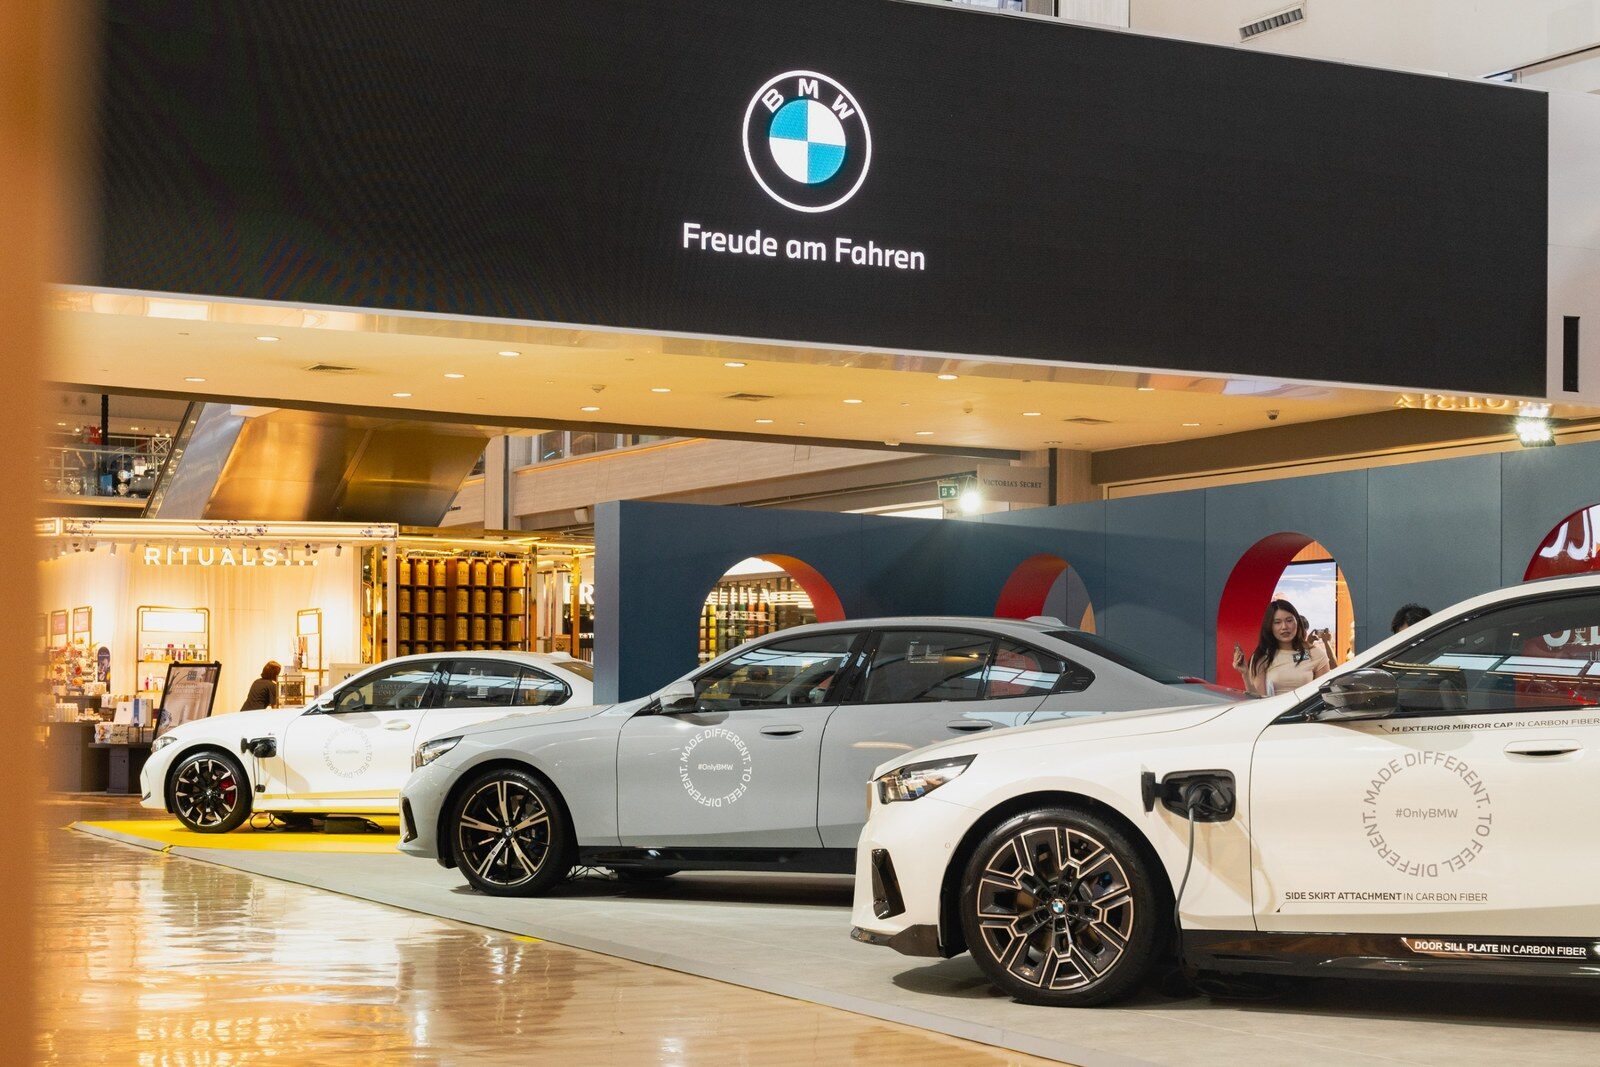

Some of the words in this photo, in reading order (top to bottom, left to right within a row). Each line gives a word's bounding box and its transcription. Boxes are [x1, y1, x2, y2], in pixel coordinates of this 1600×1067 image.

[762, 78, 855, 121] BMW
[683, 222, 777, 257] Freude
[785, 239, 826, 261] am
[835, 237, 925, 271] Fahren
[1019, 481, 1042, 489] SECRET
[1402, 724, 1451, 732] EXTERIOR
[1452, 722, 1492, 730] MIRROR
[1494, 721, 1513, 729] CAP
[1527, 719, 1569, 727] CARBON
[1571, 717, 1600, 725] FIBER
[680, 733, 703, 762] MADE
[704, 729, 752, 765] DIFFERENT.
[698, 763, 733, 771] #OnlyBMW
[742, 767, 752, 782] TO
[1404, 751, 1491, 808] DIFFERENT.
[679, 764, 722, 807] DIFFERENT.
[723, 783, 747, 804] FEEL
[1363, 759, 1402, 805] MADE
[1395, 808, 1458, 820] #OnlyBMW
[1475, 813, 1492, 837] TO
[1362, 809, 1438, 877] DIFFERENT.
[1442, 839, 1484, 872] FEEL
[1285, 892, 1306, 900] SIDE
[1308, 892, 1335, 900] SKIRT
[1338, 892, 1402, 900] ATTACHMENT
[1415, 892, 1457, 901] CARBON
[1460, 893, 1488, 901] FIBER
[1414, 941, 1443, 951] DOOR
[1444, 942, 1466, 951] SILL
[1467, 943, 1499, 953] PLATE
[1500, 944, 1511, 953] IN
[1512, 944, 1555, 955] CARBON
[1556, 946, 1586, 956] FIBER
